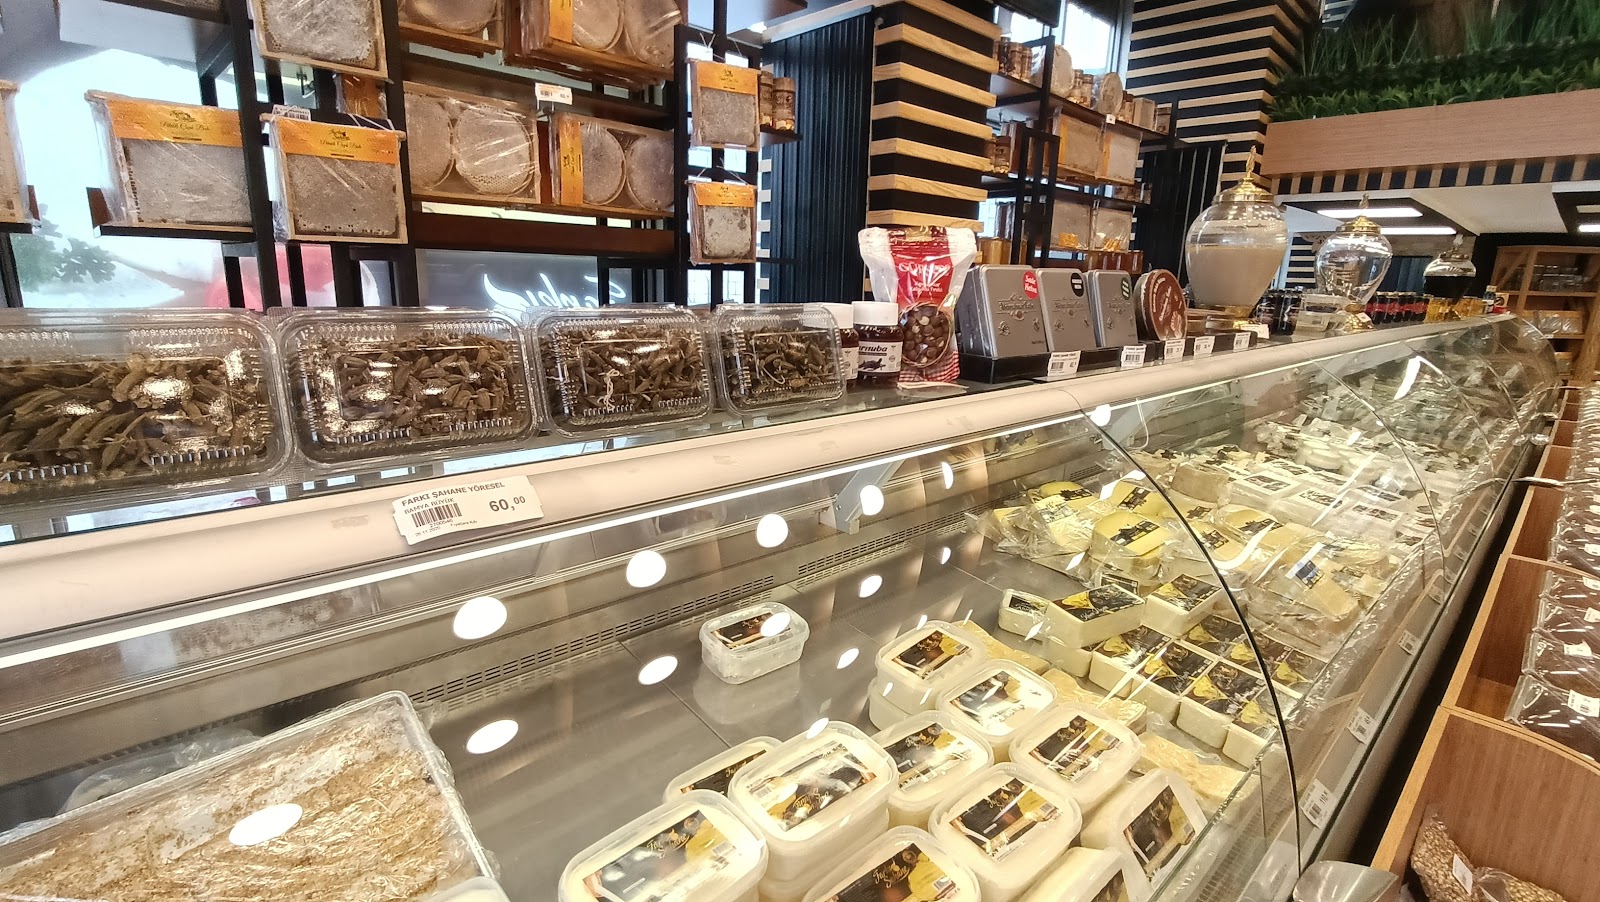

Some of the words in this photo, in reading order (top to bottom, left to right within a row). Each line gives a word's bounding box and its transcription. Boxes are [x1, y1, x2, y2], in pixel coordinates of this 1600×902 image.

[402, 493, 431, 507] FARKI
[432, 486, 467, 499] ŞAHANE
[468, 481, 506, 492] YÖRESEL
[404, 502, 430, 515] BAMYA
